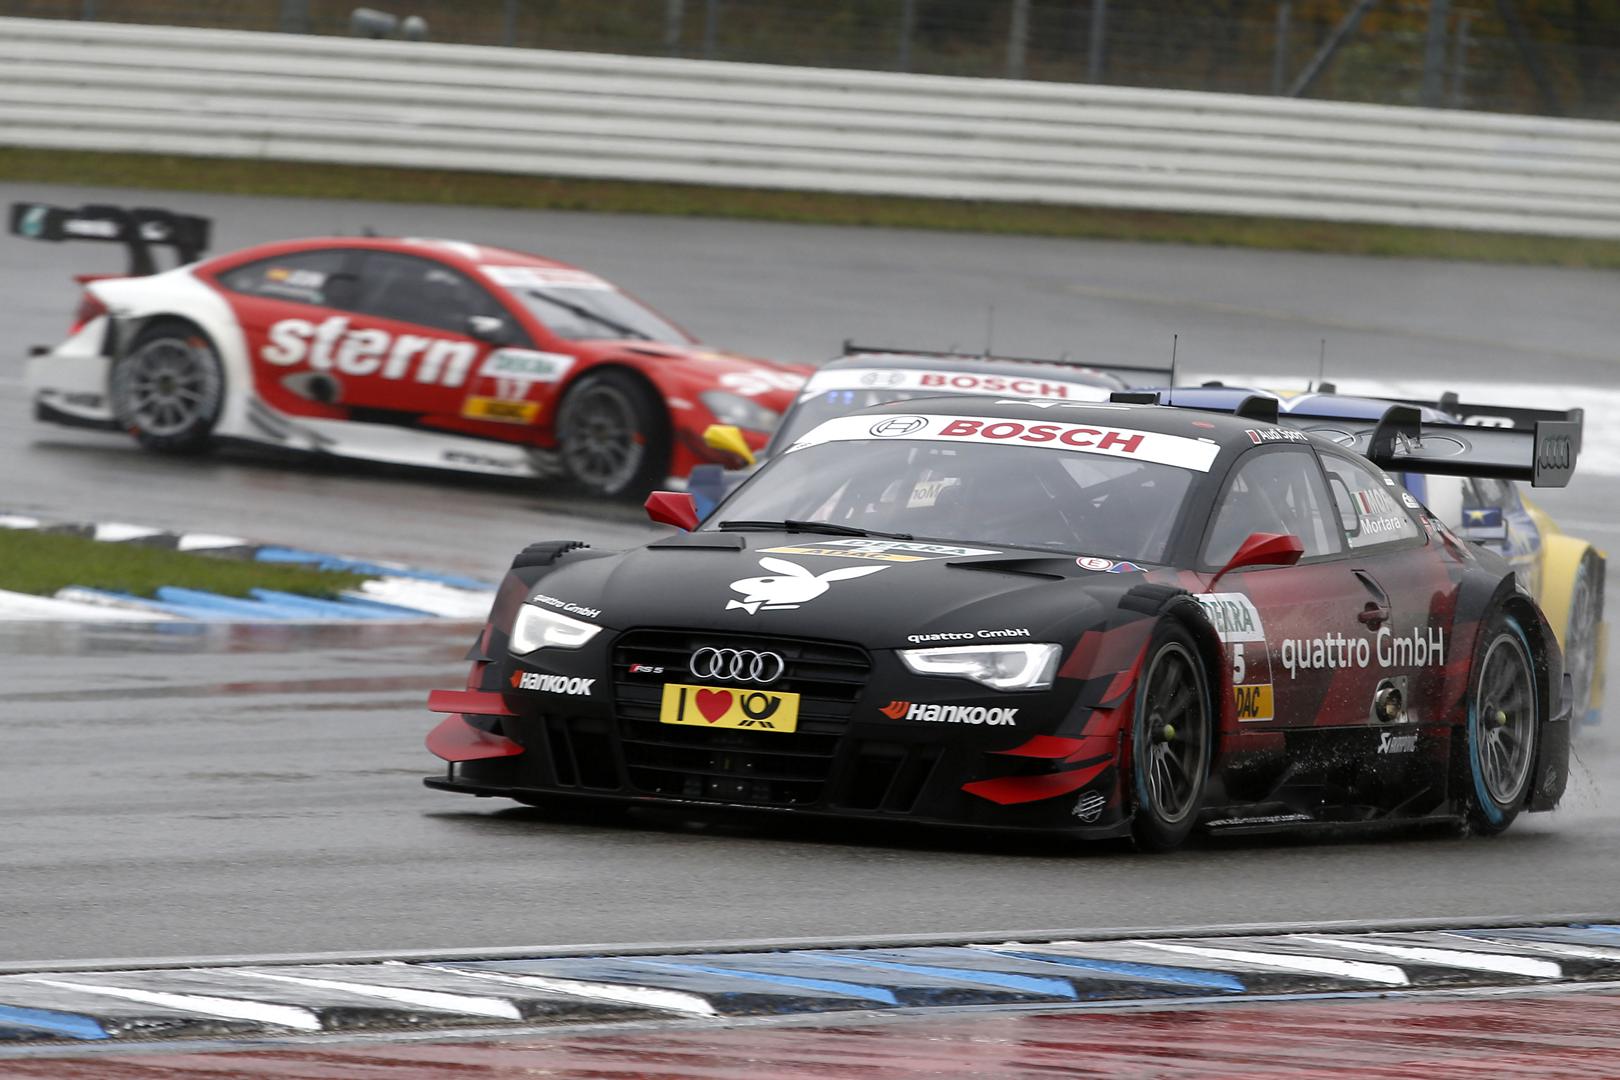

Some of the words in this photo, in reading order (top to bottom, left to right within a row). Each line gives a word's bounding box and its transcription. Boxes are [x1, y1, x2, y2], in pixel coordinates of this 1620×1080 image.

[260, 316, 478, 388] stern
[919, 373, 1068, 399] BOSCH
[937, 419, 1146, 453] BOSCH
[1257, 428, 1282, 440] Audi
[1360, 516, 1401, 536] Mortara
[840, 540, 970, 555] DEKRA
[563, 603, 602, 618] GmbH
[907, 632, 975, 644] quattro
[976, 628, 1031, 639] GmbH
[1232, 643, 1246, 685] 5
[1281, 632, 1370, 680] quattro
[1376, 627, 1444, 668] GmbH
[676, 687, 687, 722] I
[1236, 686, 1260, 718] DAC
